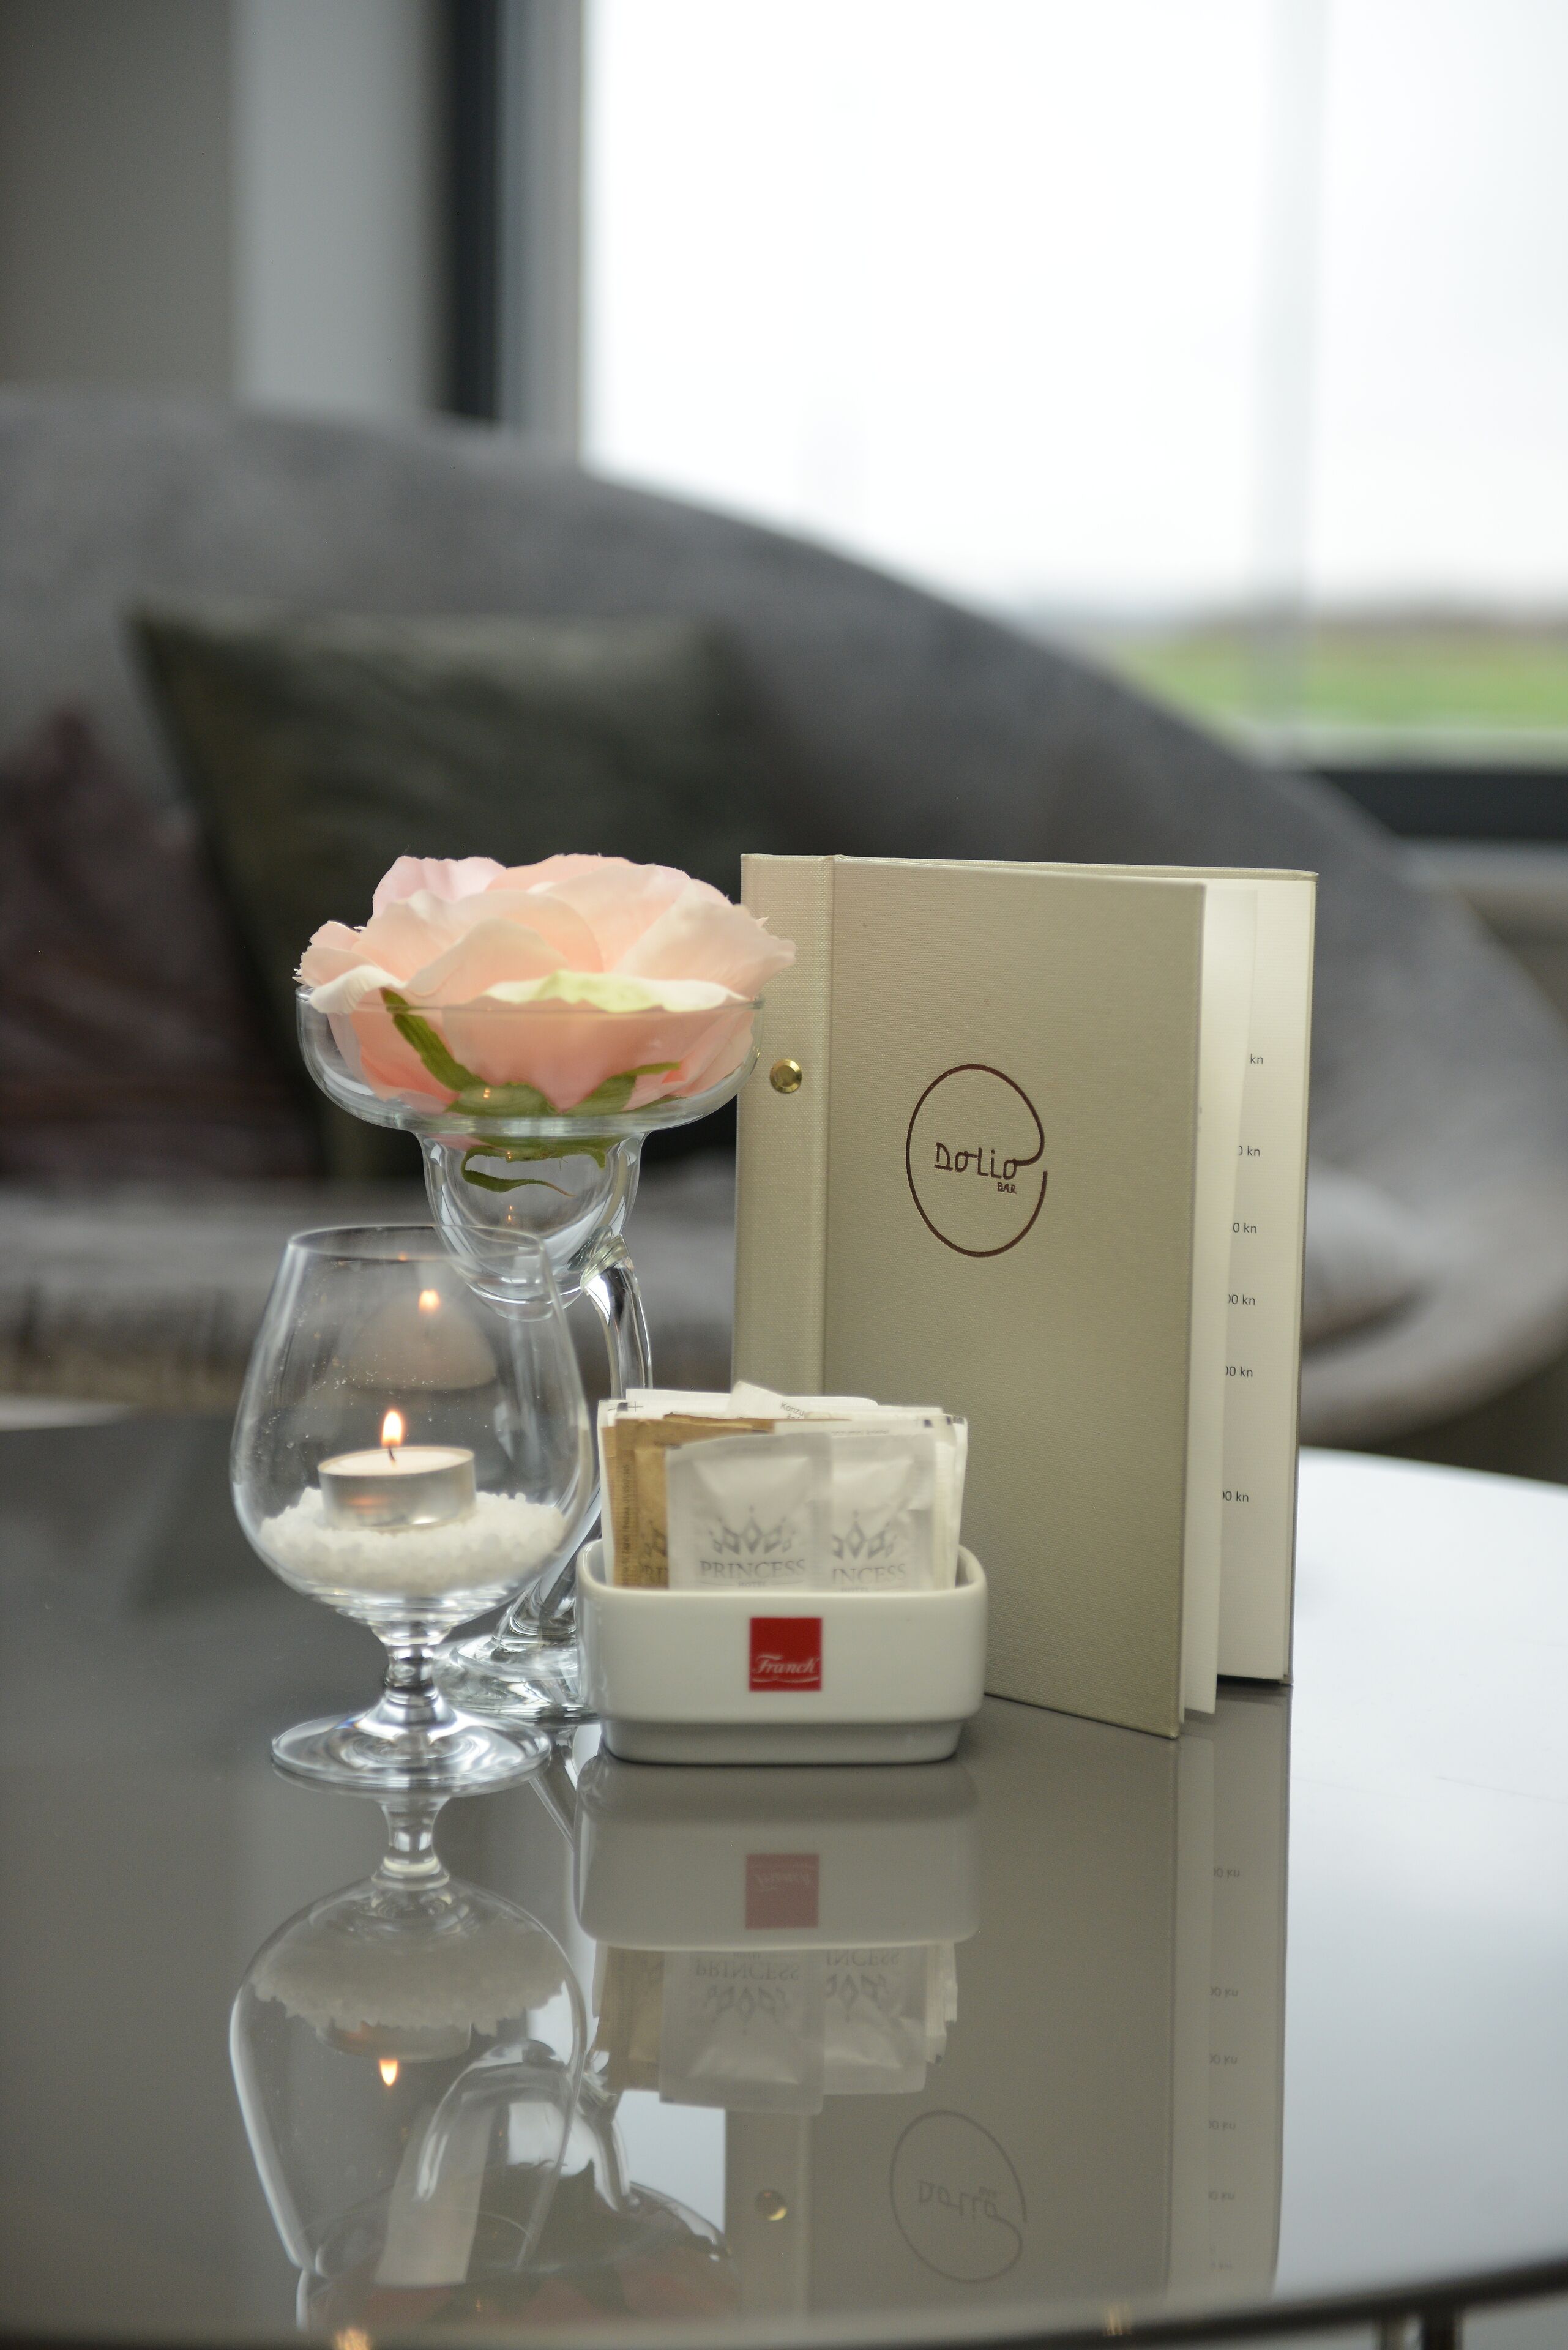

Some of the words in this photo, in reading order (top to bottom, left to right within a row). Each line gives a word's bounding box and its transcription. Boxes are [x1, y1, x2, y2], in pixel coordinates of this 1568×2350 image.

[1250, 1053, 1264, 1065] kn
[1247, 1146, 1261, 1157] kn
[997, 1182, 1017, 1194] BAR
[1244, 1222, 1257, 1234] kn
[1242, 1294, 1255, 1306] kn
[1240, 1366, 1253, 1378] kn
[780, 1401, 806, 1416] Konzu
[1236, 1490, 1249, 1502] kn
[700, 1559, 807, 1580] PRINCESS
[753, 1654, 821, 1674] Franck
